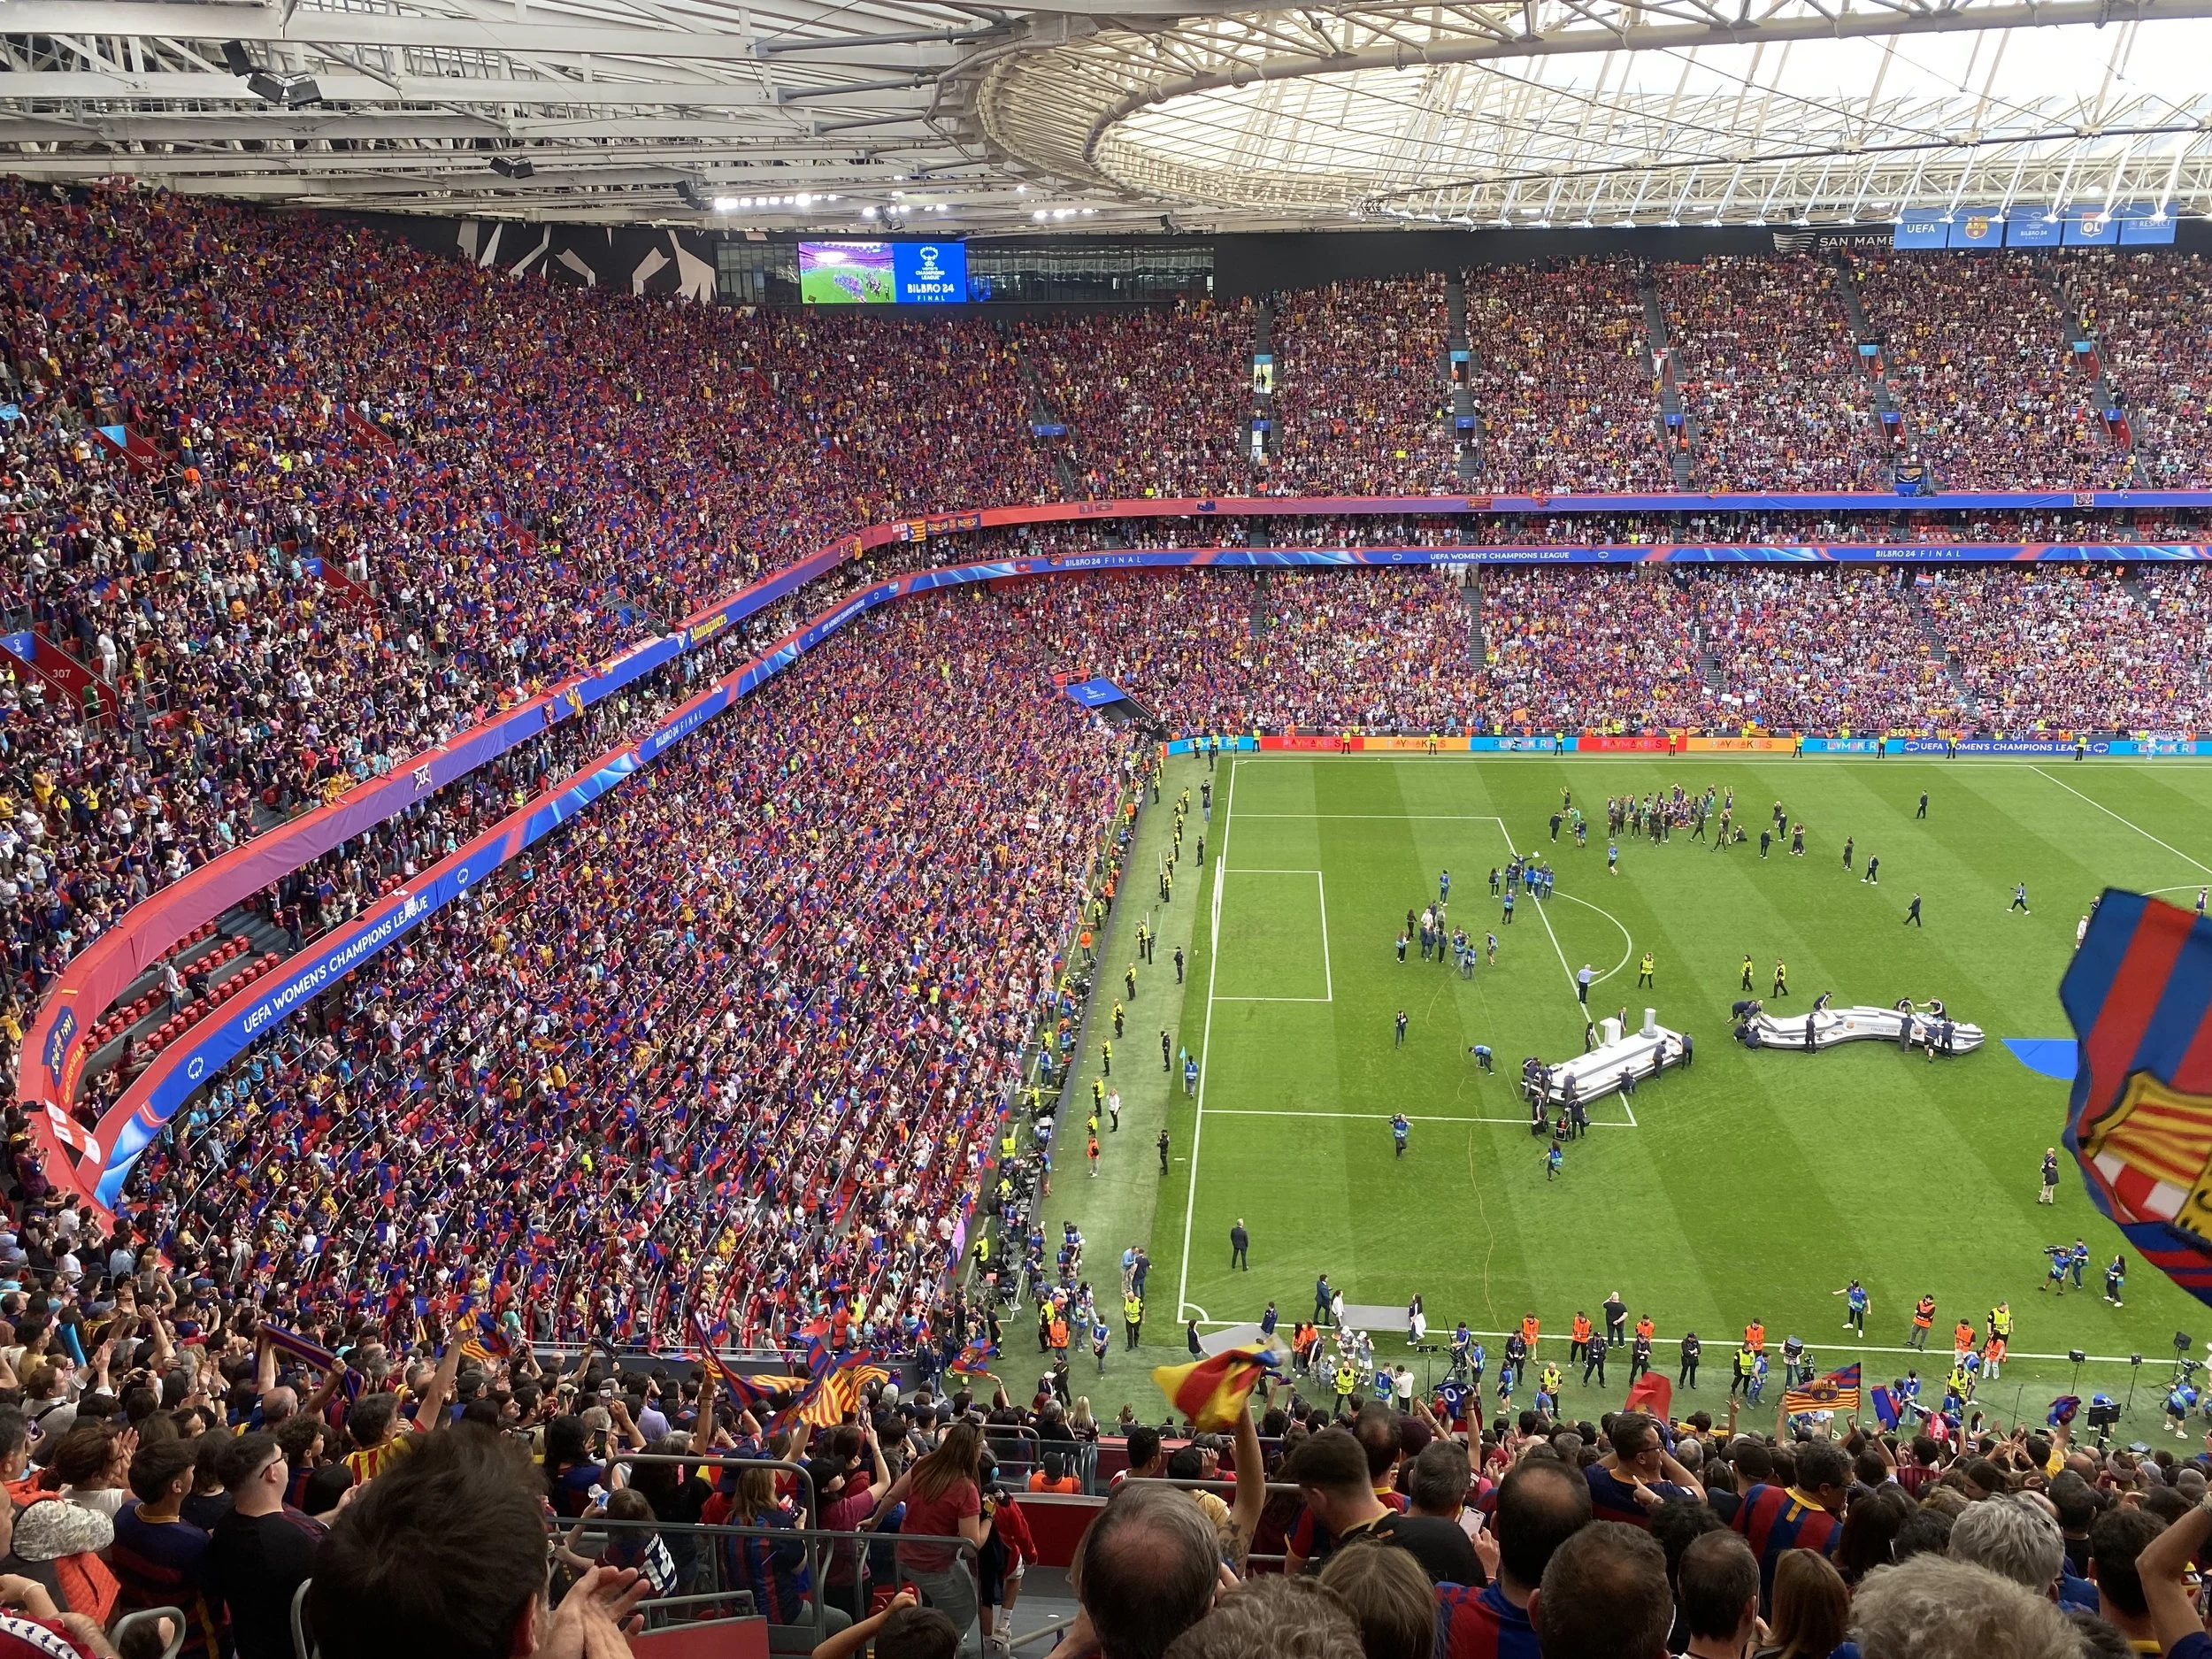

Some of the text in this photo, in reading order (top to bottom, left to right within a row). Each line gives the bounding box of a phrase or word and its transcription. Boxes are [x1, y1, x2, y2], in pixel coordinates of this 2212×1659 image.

[1907, 224, 1935, 233] UEFA
[1819, 235, 1894, 247] SAN MAME
[941, 283, 955, 293] 24
[1920, 549, 1962, 558] FINAL
[1104, 556, 1141, 565] FINAL
[53, 669, 72, 679] 307
[680, 709, 703, 732] FINAL
[1387, 739, 1447, 749] PLAYMAKS
[1821, 740, 1879, 750] PLAYMAKER
[1993, 743, 2053, 753] CHAMPIONS
[2055, 744, 2092, 753] LEAGE
[243, 1003, 273, 1033] UEFA
[272, 964, 327, 1010] WOMEN'S
[329, 920, 392, 972] CHAMPIONS
